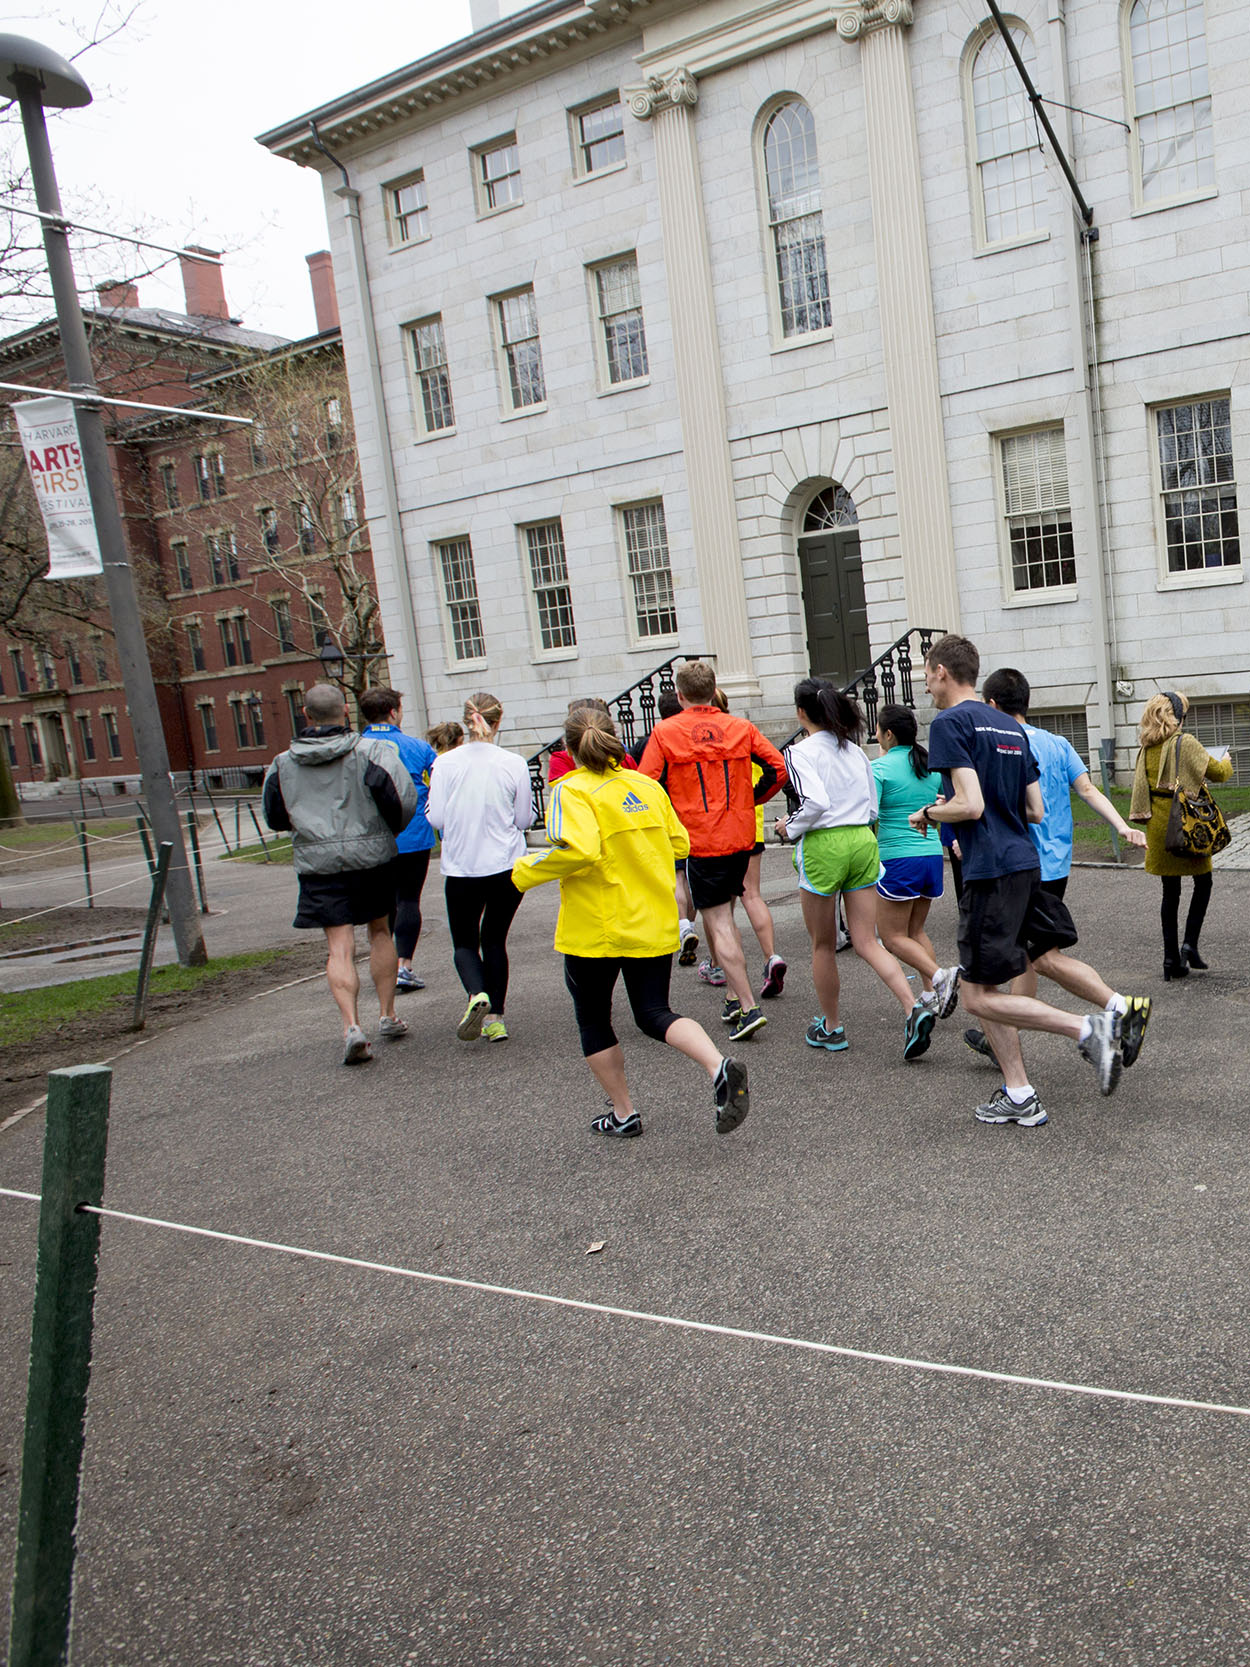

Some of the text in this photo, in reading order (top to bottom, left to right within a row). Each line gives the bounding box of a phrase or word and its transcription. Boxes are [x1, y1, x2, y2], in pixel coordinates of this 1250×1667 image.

[24, 425, 76, 440] HARVARD
[29, 442, 81, 473] ARTS
[33, 465, 86, 494] FIRST
